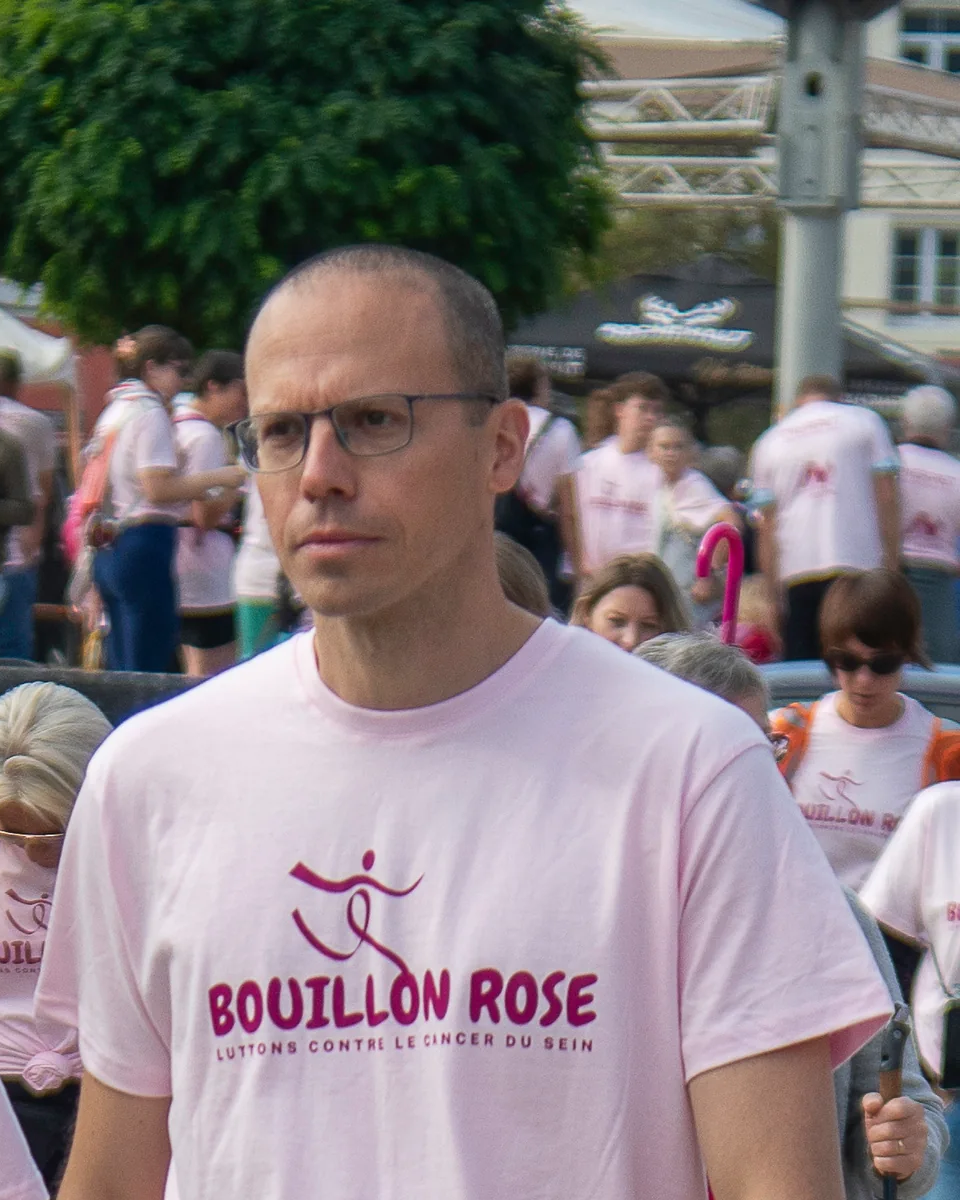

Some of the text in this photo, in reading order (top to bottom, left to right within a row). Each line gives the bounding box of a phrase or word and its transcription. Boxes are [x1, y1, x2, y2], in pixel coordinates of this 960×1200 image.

[799, 803, 875, 827] UILLON
[208, 967, 598, 1037] BOUILLON ROSE
[216, 1031, 593, 1062] LUTTONS CONTRE LE CANCER DU SEIN
